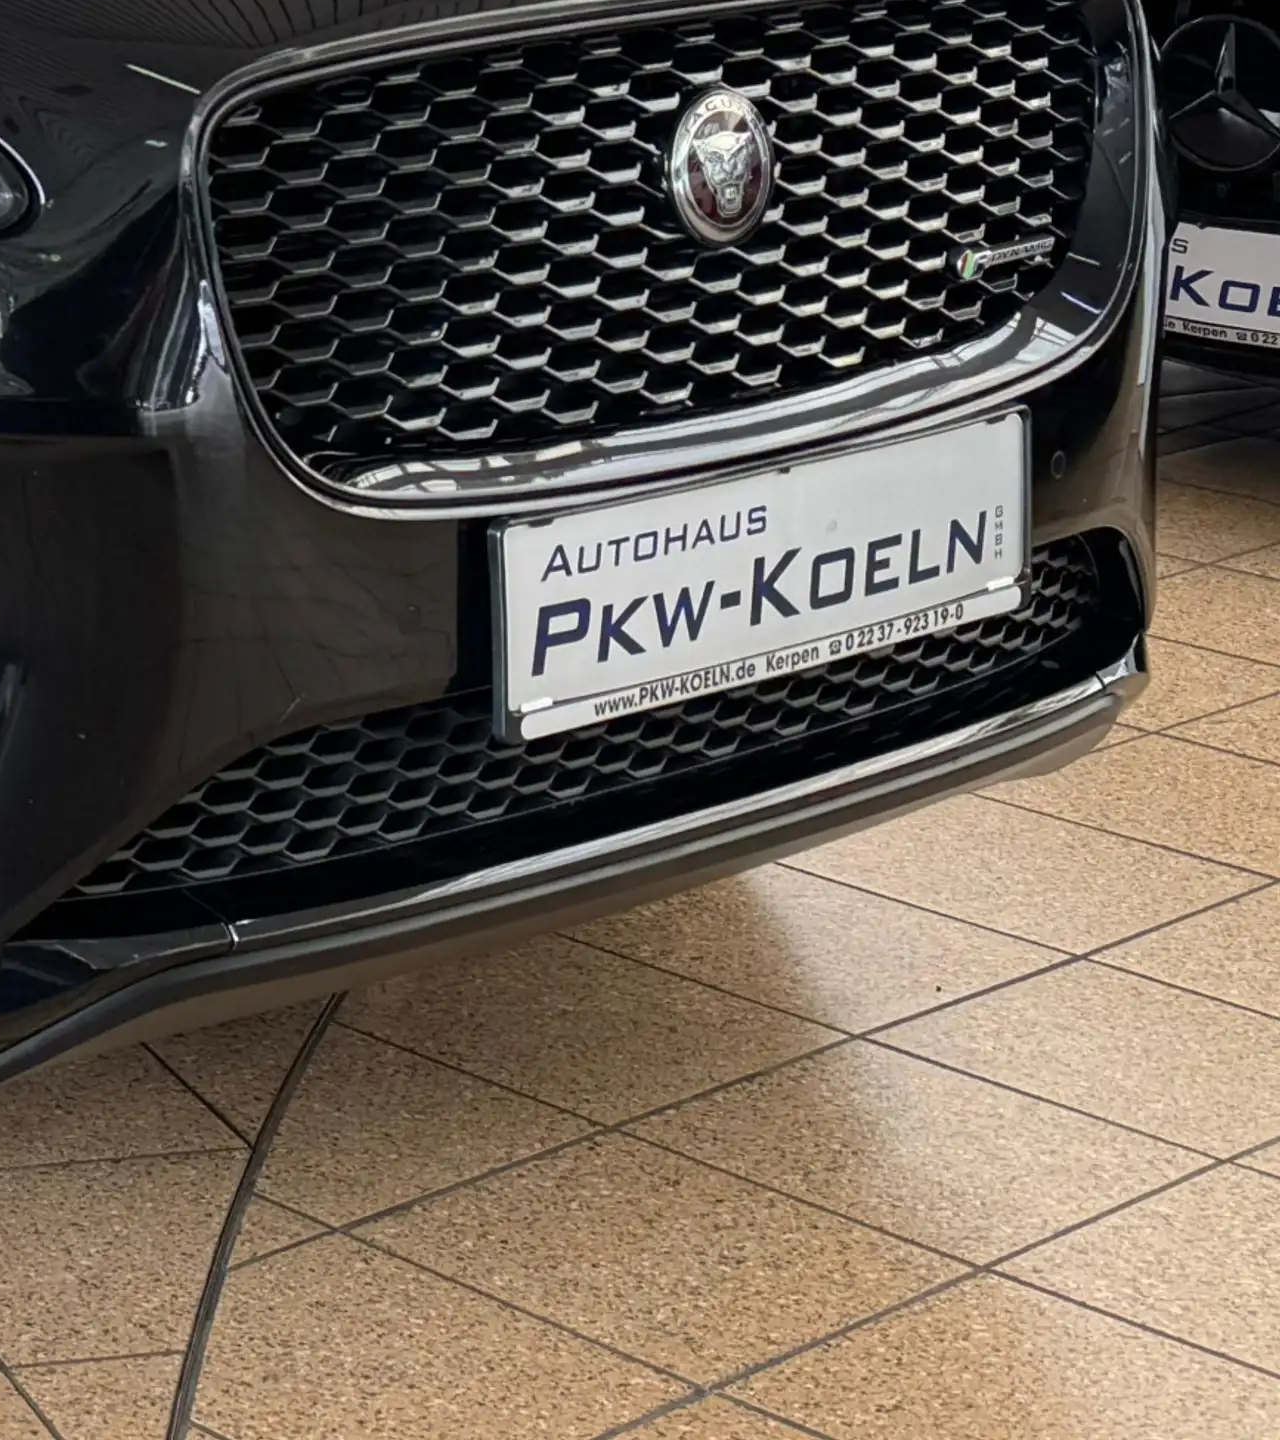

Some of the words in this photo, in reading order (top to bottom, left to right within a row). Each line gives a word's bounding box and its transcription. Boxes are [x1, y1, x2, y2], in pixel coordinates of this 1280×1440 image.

[541, 505, 768, 583] AUTOHAUS
[531, 510, 988, 677] PKW-KOELN
[593, 661, 756, 717] www.PKW-KOELN.de
[766, 645, 819, 673] Kerpen
